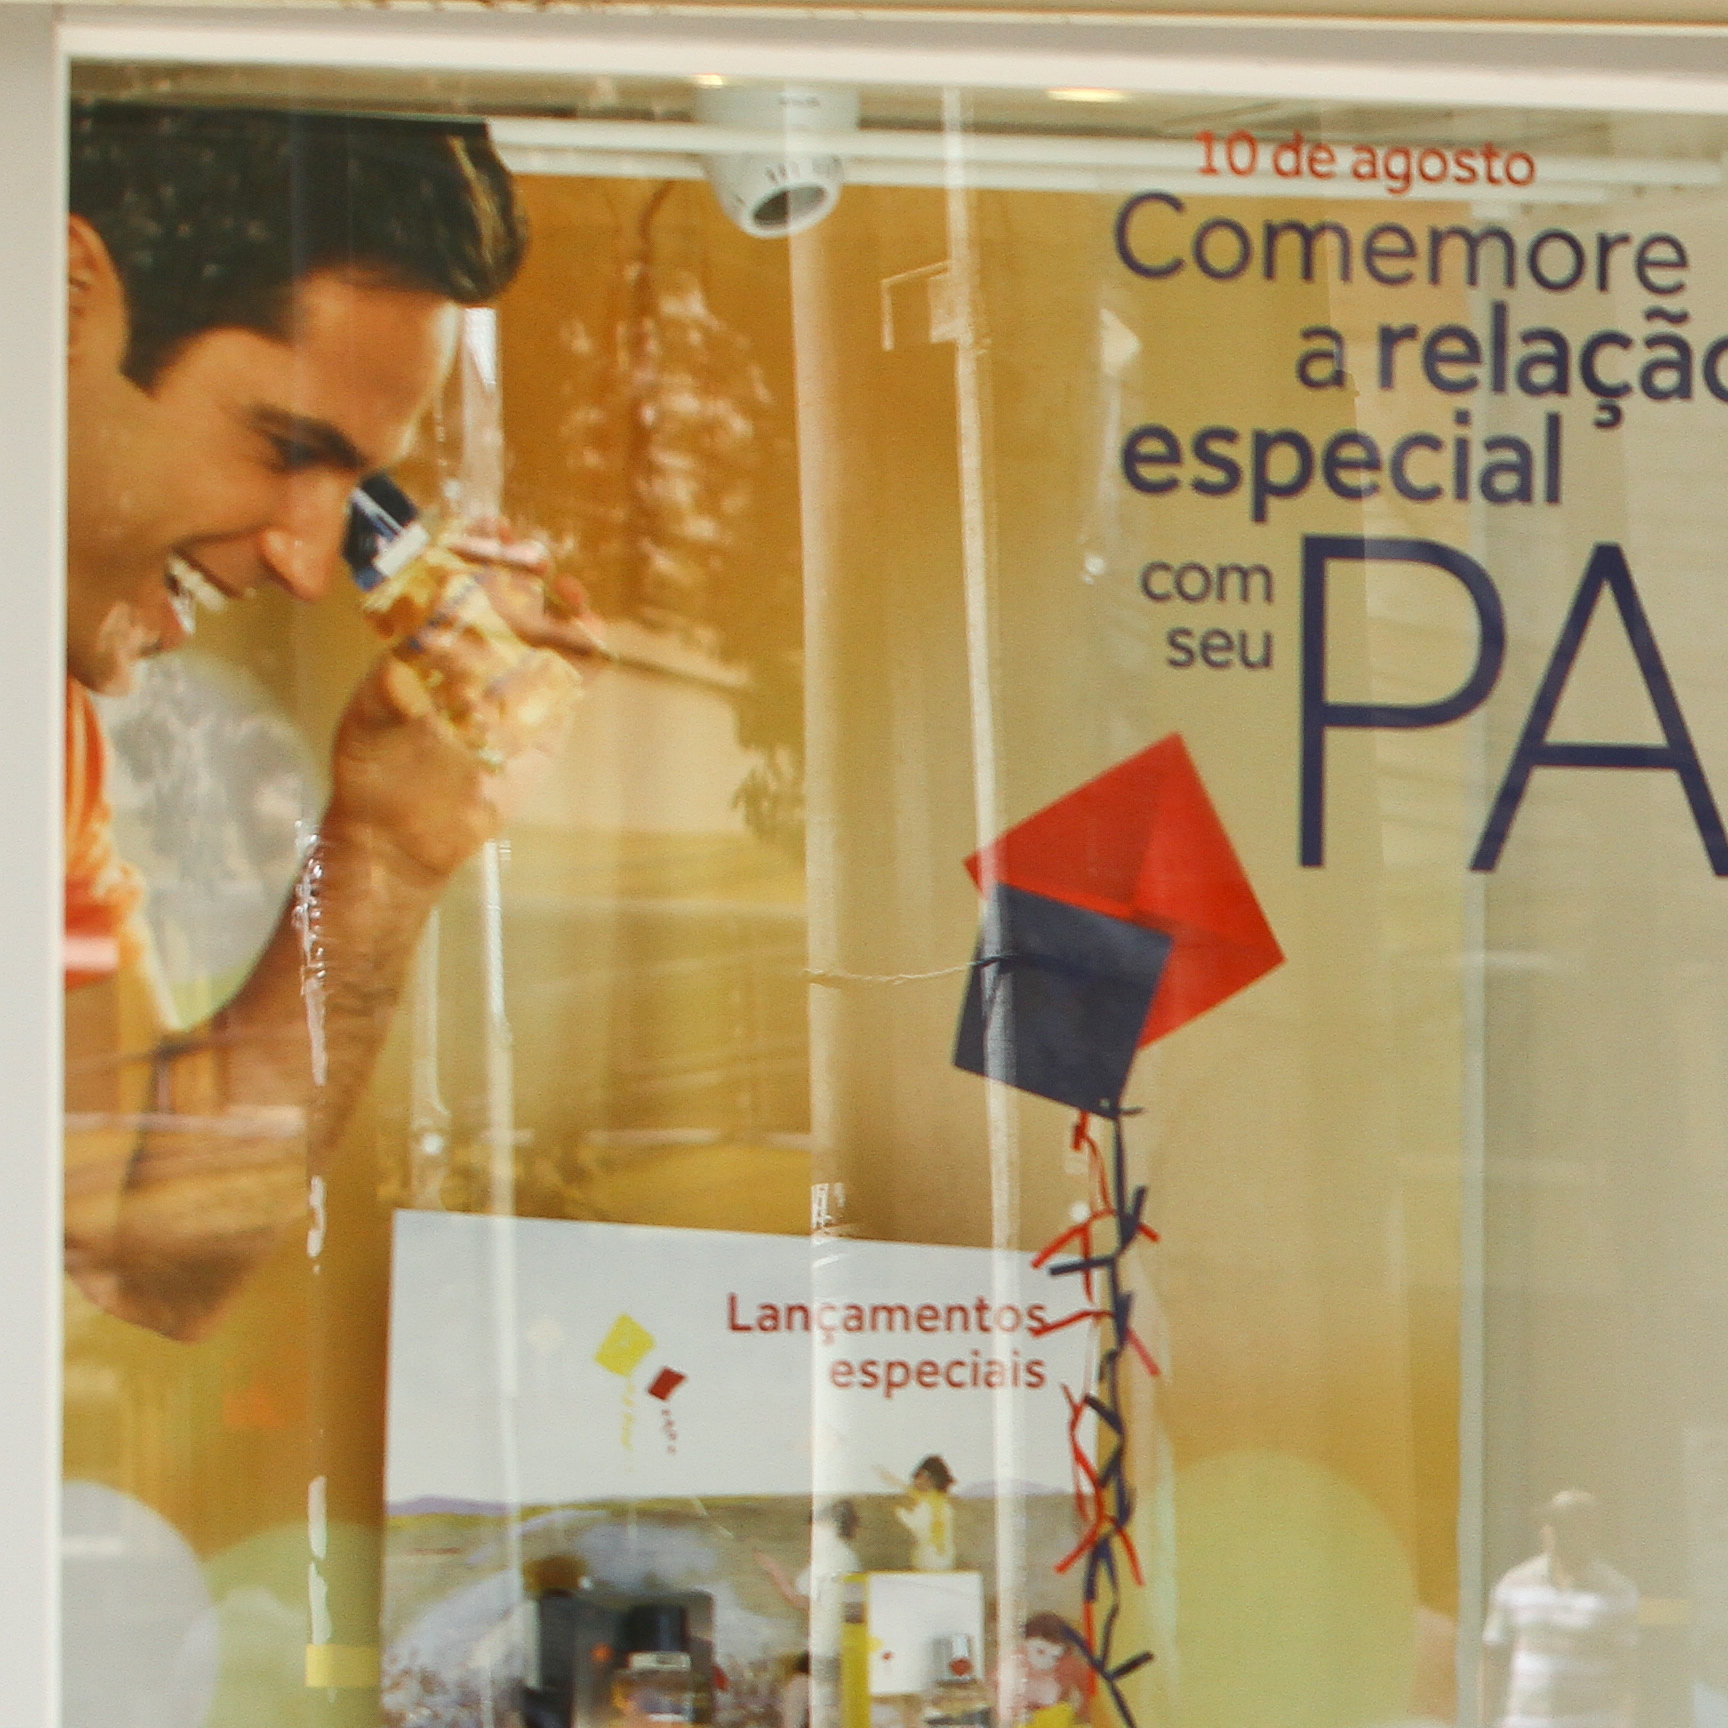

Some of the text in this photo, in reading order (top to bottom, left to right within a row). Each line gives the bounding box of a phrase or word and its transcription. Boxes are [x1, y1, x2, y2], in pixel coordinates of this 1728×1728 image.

[1198, 130, 1537, 194] 10 de agosto
[1115, 190, 1689, 296] Comemore
[1297, 325, 1346, 388] a
[1121, 410, 1562, 523] especial
[1141, 559, 1273, 604] com
[1166, 625, 1272, 670] seu
[727, 1291, 1048, 1345] Lançamentos
[829, 1352, 1046, 1397] especiais
